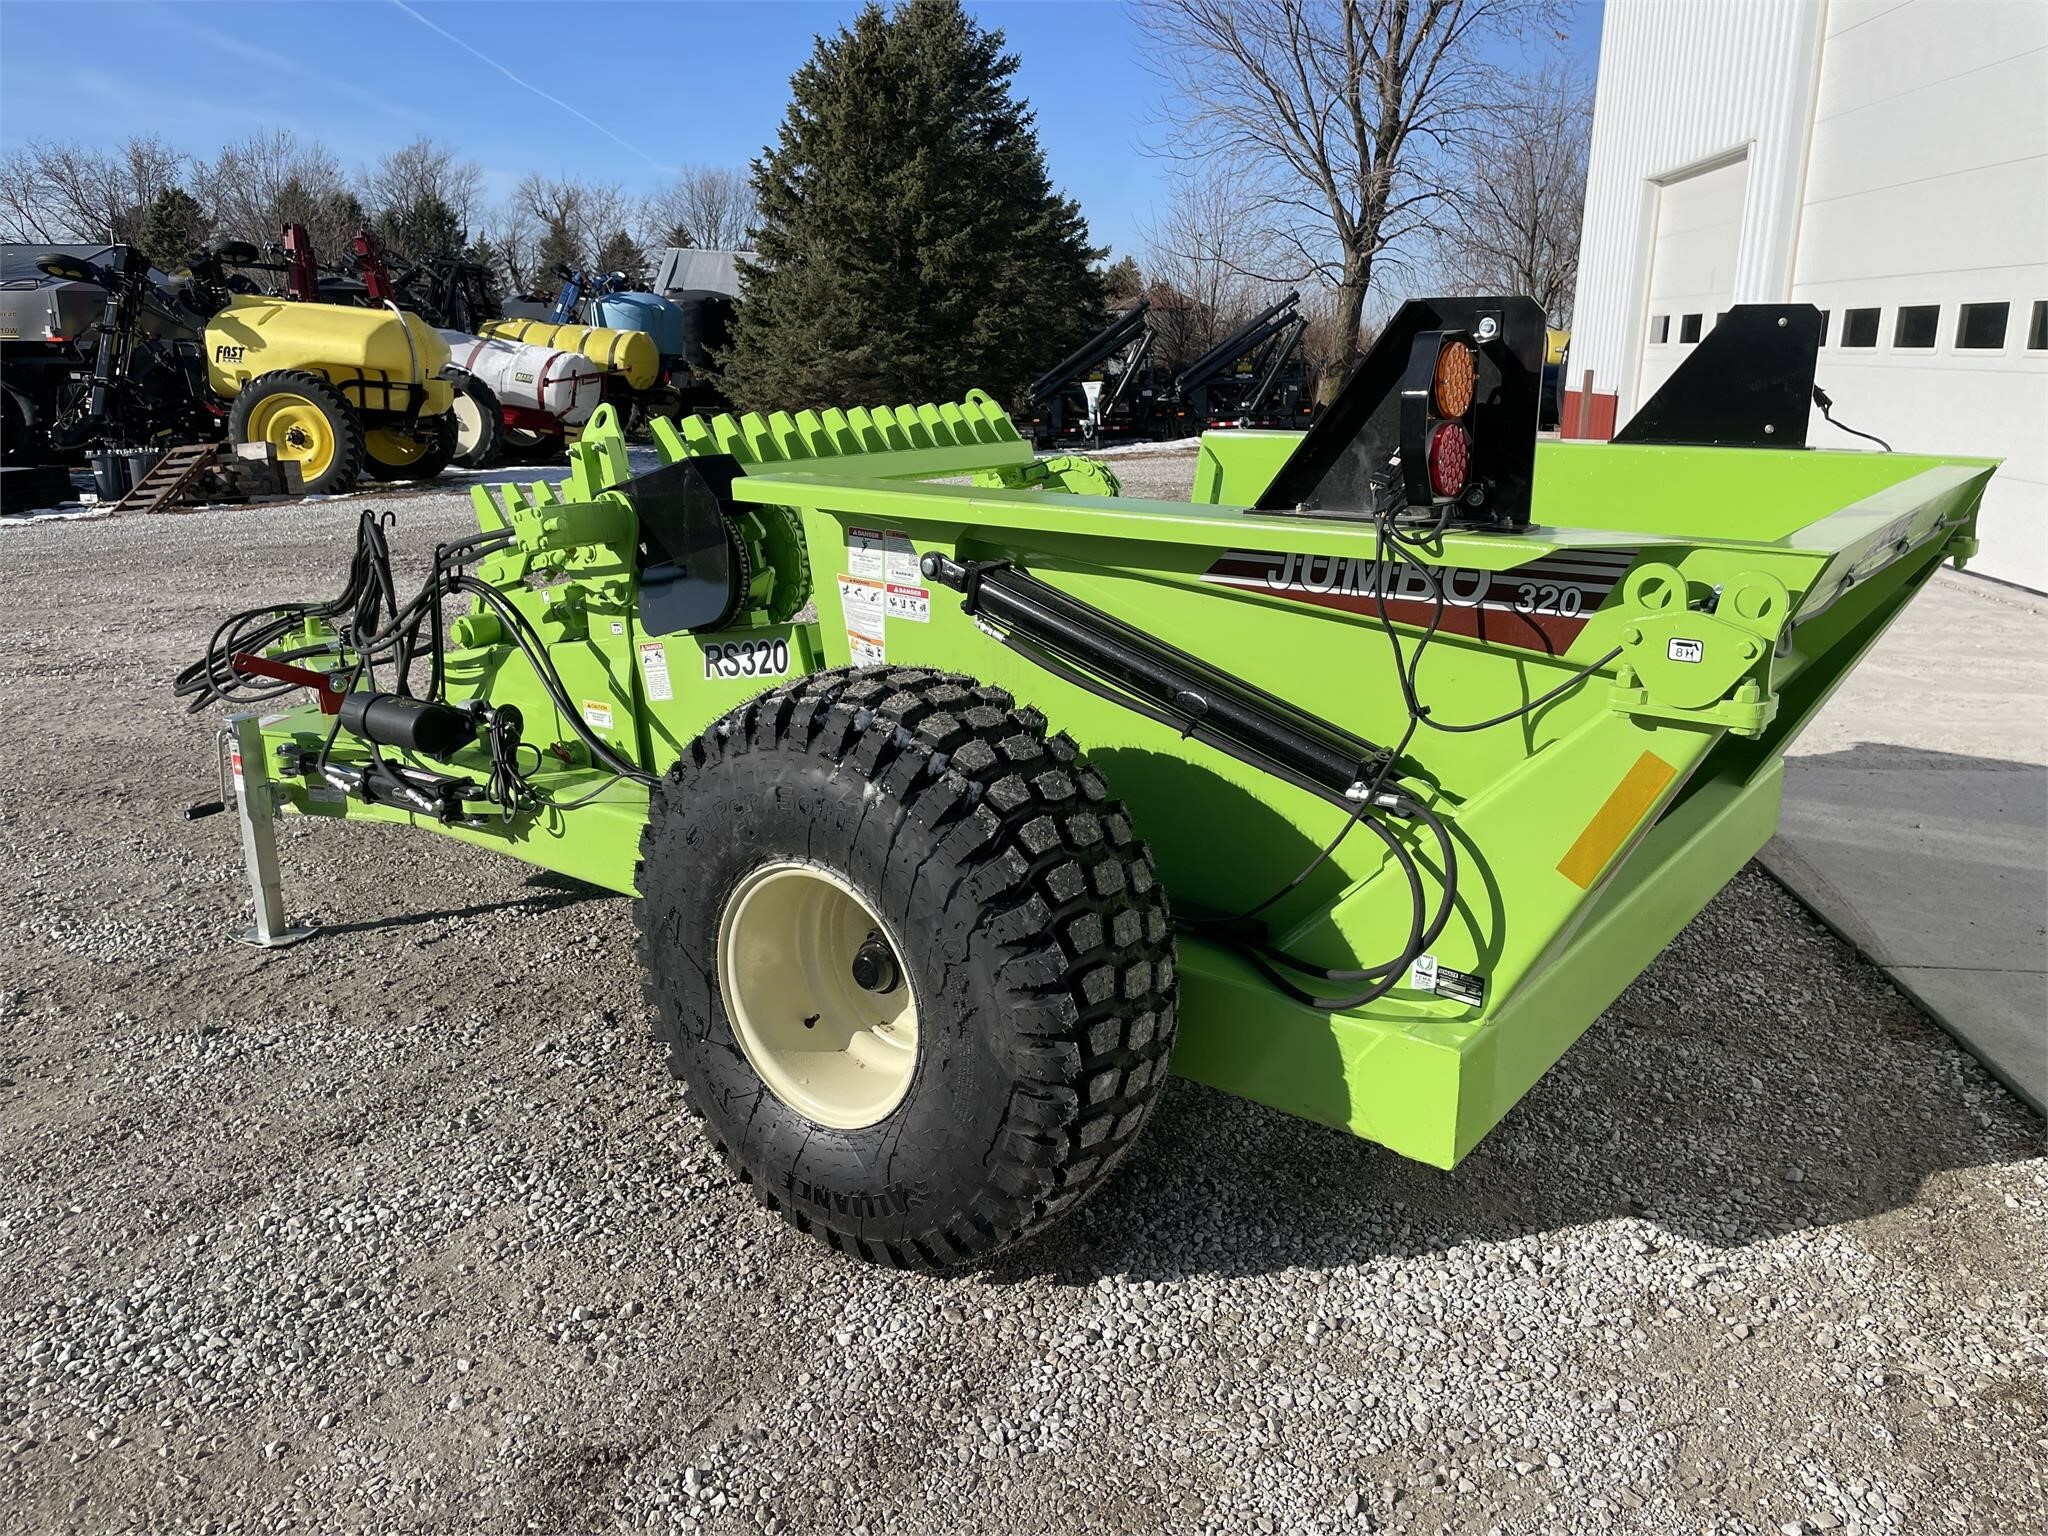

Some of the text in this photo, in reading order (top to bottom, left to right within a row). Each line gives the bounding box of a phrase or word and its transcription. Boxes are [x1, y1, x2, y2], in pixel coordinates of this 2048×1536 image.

[215, 345, 245, 363] FAST
[899, 588, 922, 596] DANGER
[1266, 553, 1493, 607] JUMBO
[1513, 583, 1583, 618] 320
[704, 639, 788, 679] RS320
